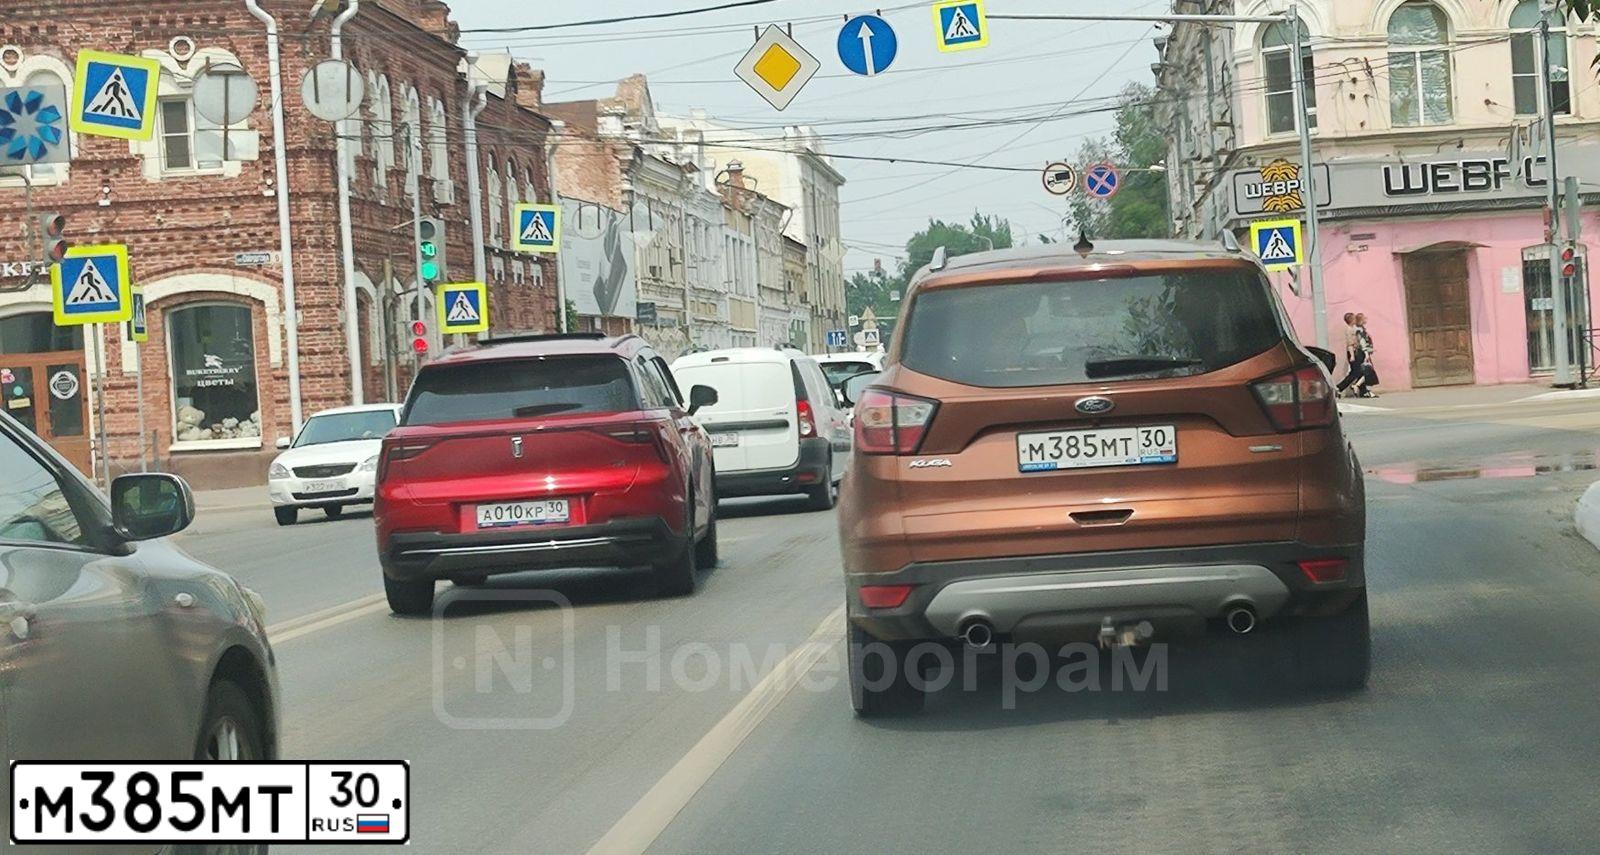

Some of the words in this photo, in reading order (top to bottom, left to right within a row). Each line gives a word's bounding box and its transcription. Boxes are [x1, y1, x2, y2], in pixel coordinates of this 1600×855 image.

[1084, 399, 1107, 411] Ford
[1028, 434, 1132, 462] М385МТ
[1141, 429, 1166, 448] 30
[910, 459, 952, 468] KUGA
[483, 504, 544, 521] А010КР
[548, 501, 563, 513] 30
